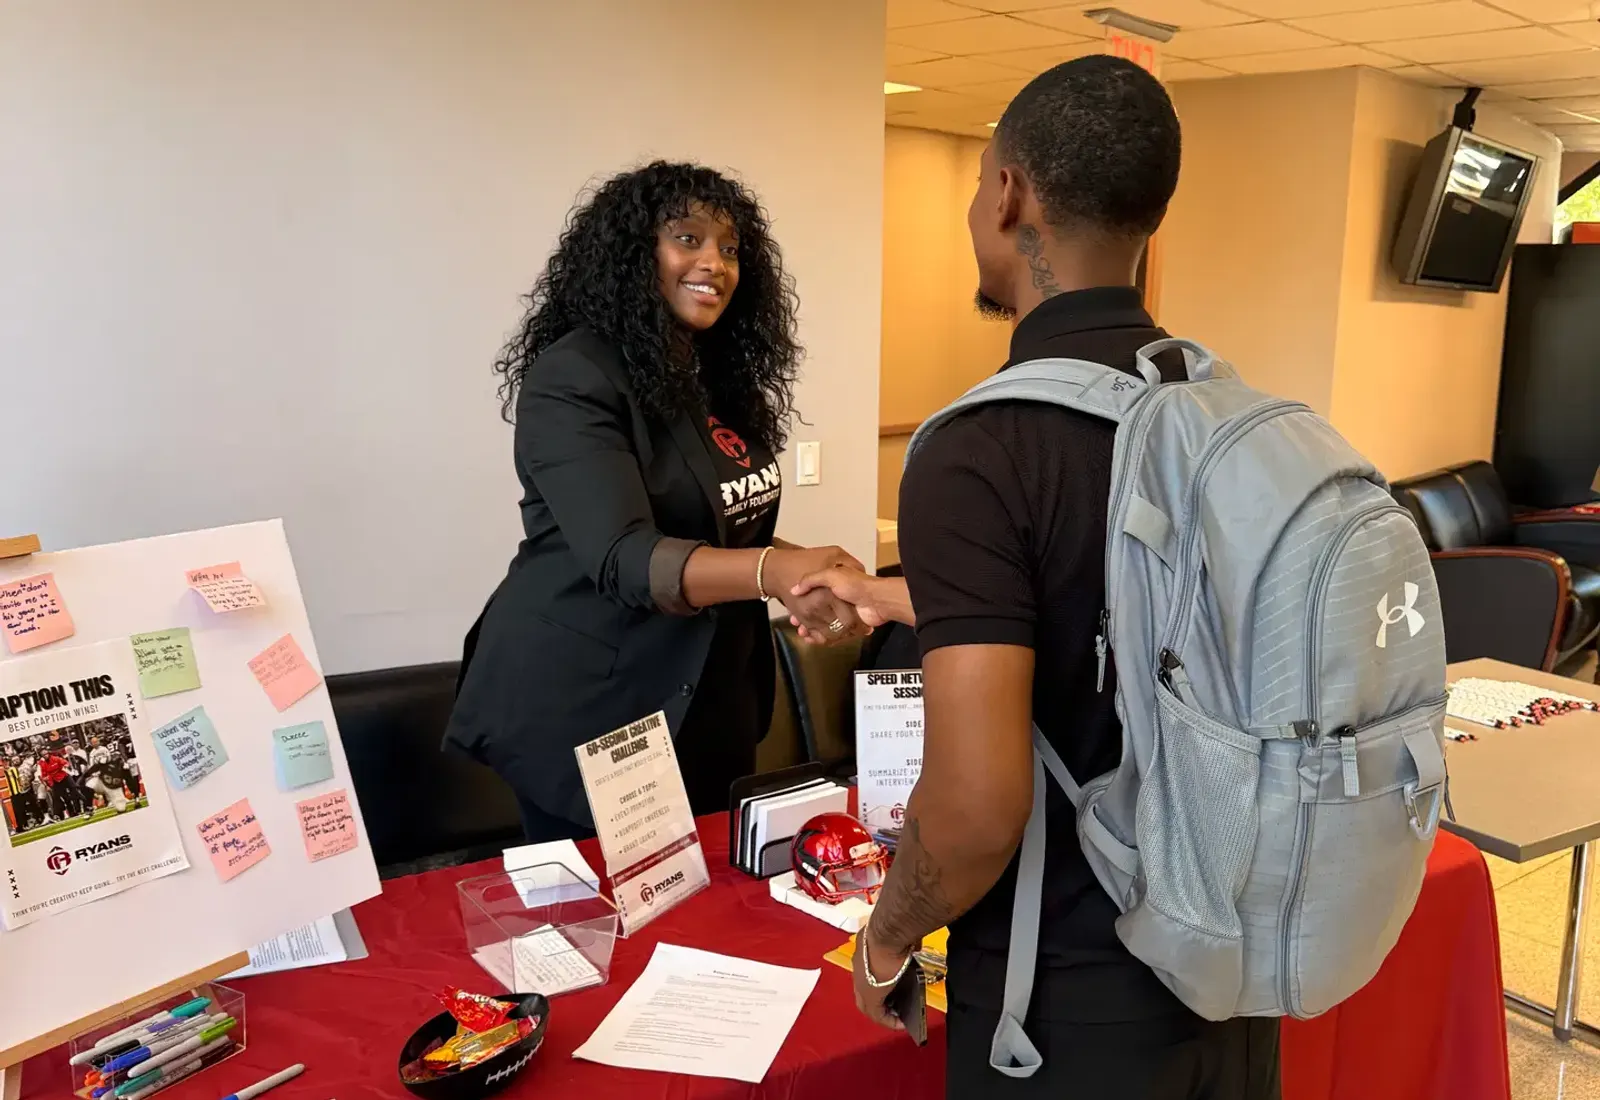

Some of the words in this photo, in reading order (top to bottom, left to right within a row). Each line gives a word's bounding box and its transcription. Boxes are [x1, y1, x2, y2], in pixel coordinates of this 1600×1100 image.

[69, 674, 116, 703] THIS
[868, 674, 898, 686] SPEED
[8, 720, 31, 733] BEST
[34, 710, 71, 727] CAPTION
[73, 703, 99, 717] WINS!
[629, 715, 662, 738] CREATIVE
[906, 720, 922, 728] SIDE
[870, 730, 892, 739] SHARE
[896, 730, 914, 738] YOUR
[611, 736, 650, 764] CHALLENGE
[868, 768, 907, 778] SUMMARIZE
[906, 758, 923, 766] SIDE
[74, 834, 131, 859] RYANS
[12, 907, 29, 919] THINK
[49, 891, 79, 906] CREATIVE?
[79, 886, 93, 896] KEEP
[137, 866, 151, 876] NEXT
[654, 870, 685, 894] RYANS
